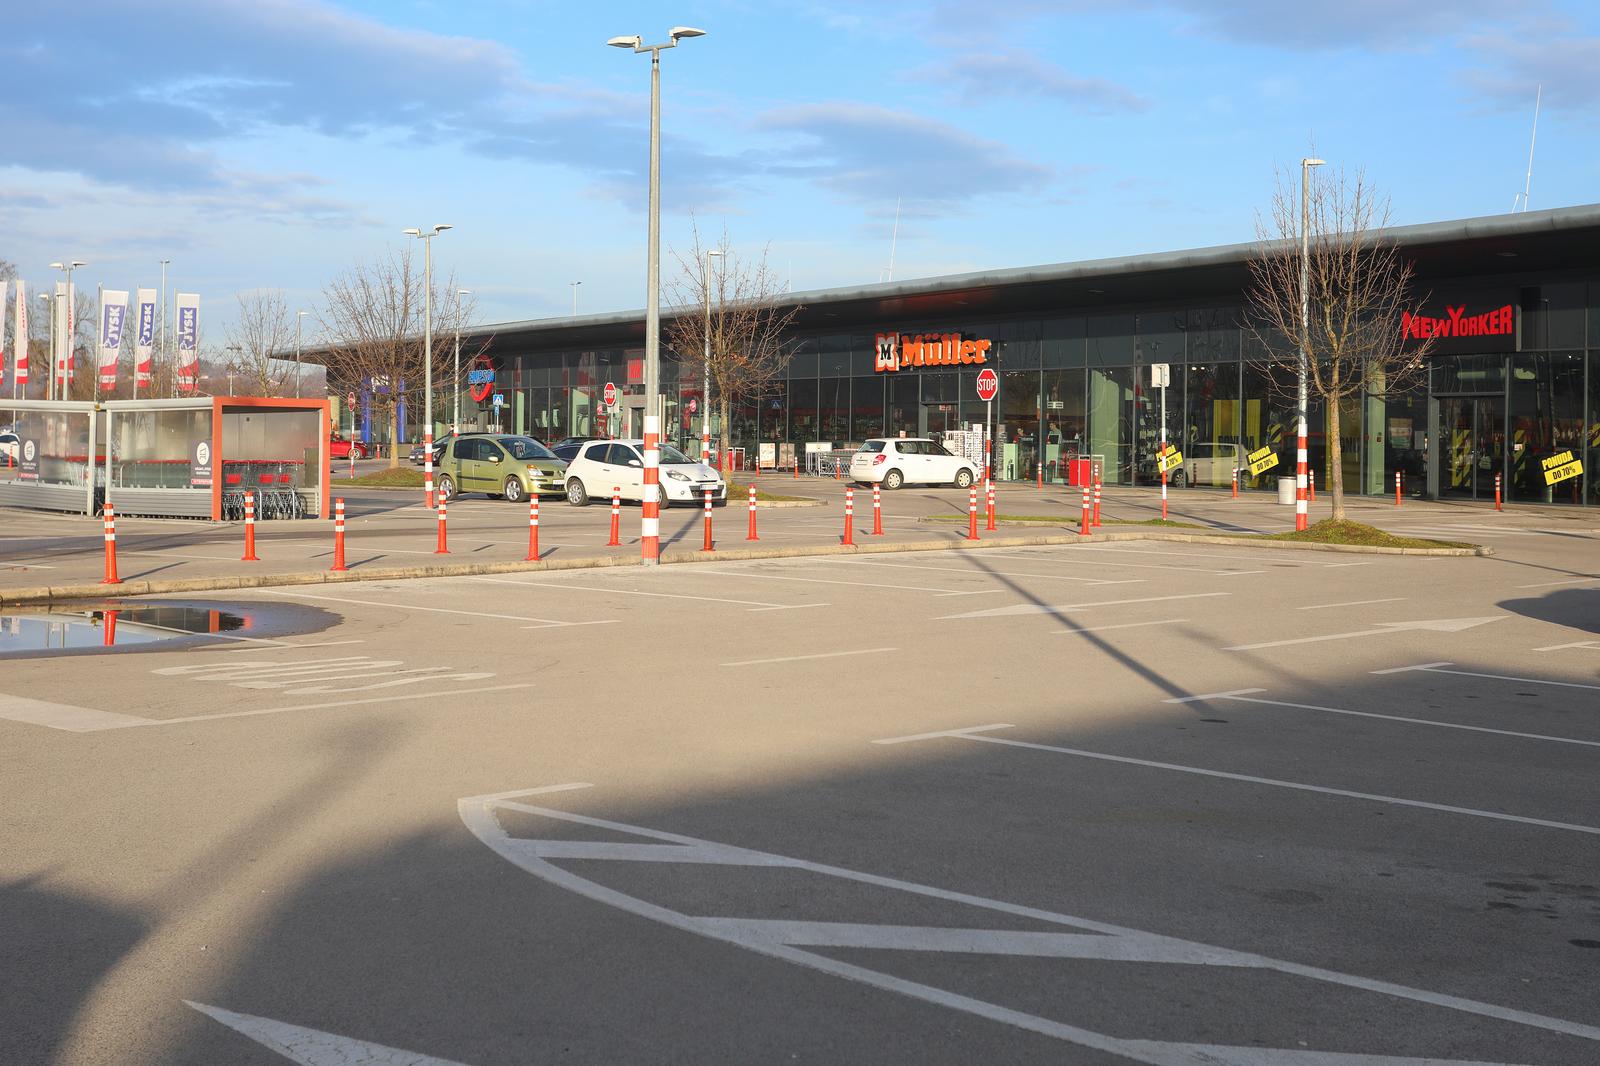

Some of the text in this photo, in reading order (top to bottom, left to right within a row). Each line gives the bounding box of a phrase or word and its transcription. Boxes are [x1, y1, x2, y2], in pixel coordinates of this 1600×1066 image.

[107, 306, 121, 340] JYSK
[143, 304, 152, 338] JYSK
[183, 309, 194, 342] JYSK
[900, 332, 991, 367] Müller
[604, 390, 615, 398] STOP
[978, 378, 996, 391] STOP
[1541, 450, 1574, 470] PONUDA
[1552, 466, 1576, 480] DO 70%
